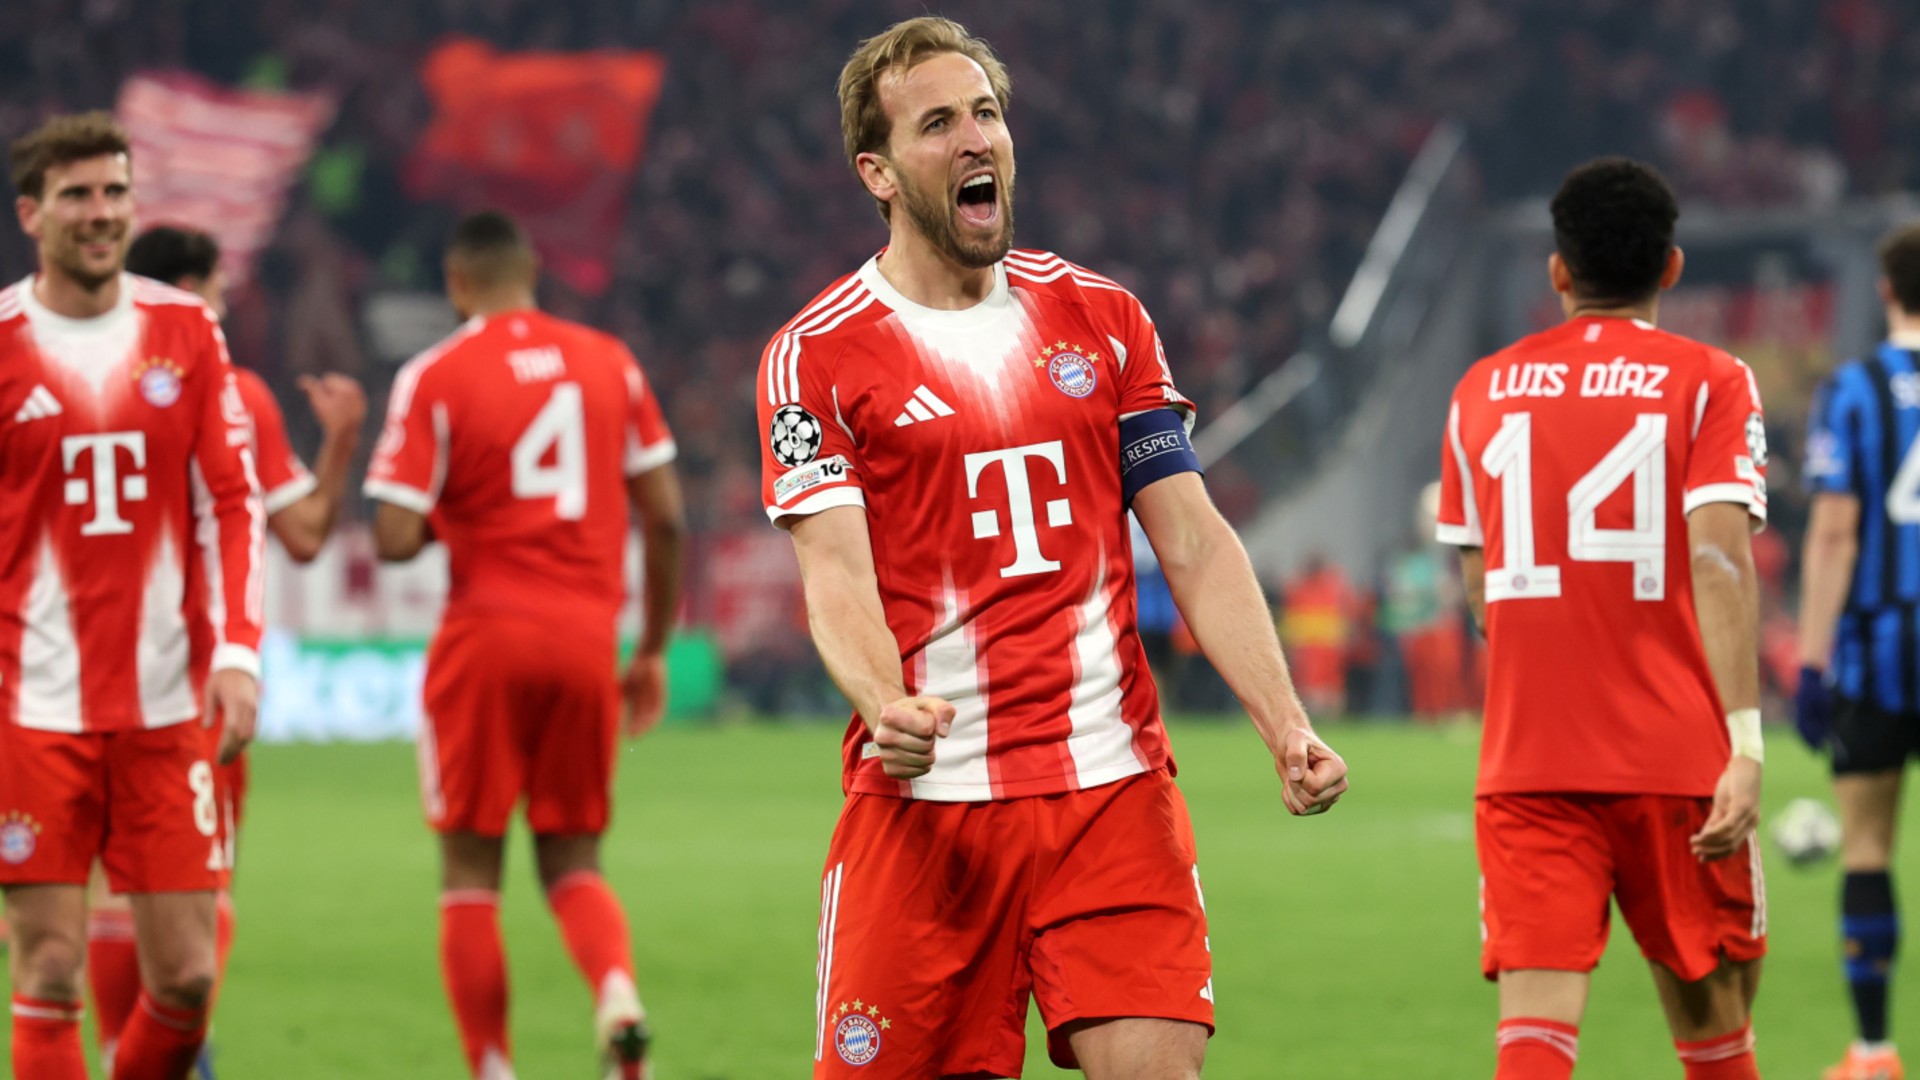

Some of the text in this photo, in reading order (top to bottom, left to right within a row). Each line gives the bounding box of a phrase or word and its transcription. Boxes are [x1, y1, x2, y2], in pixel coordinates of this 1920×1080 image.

[1057, 355, 1089, 371] BAYERN
[1488, 356, 1669, 400] LUIS DÍAZ
[62, 430, 146, 536] T
[510, 380, 588, 521] 4
[1126, 434, 1181, 462] RESPECT
[964, 440, 1069, 578] T
[1481, 411, 1668, 603] 14
[188, 760, 217, 836] 8
[847, 1018, 876, 1038] BAYERN
